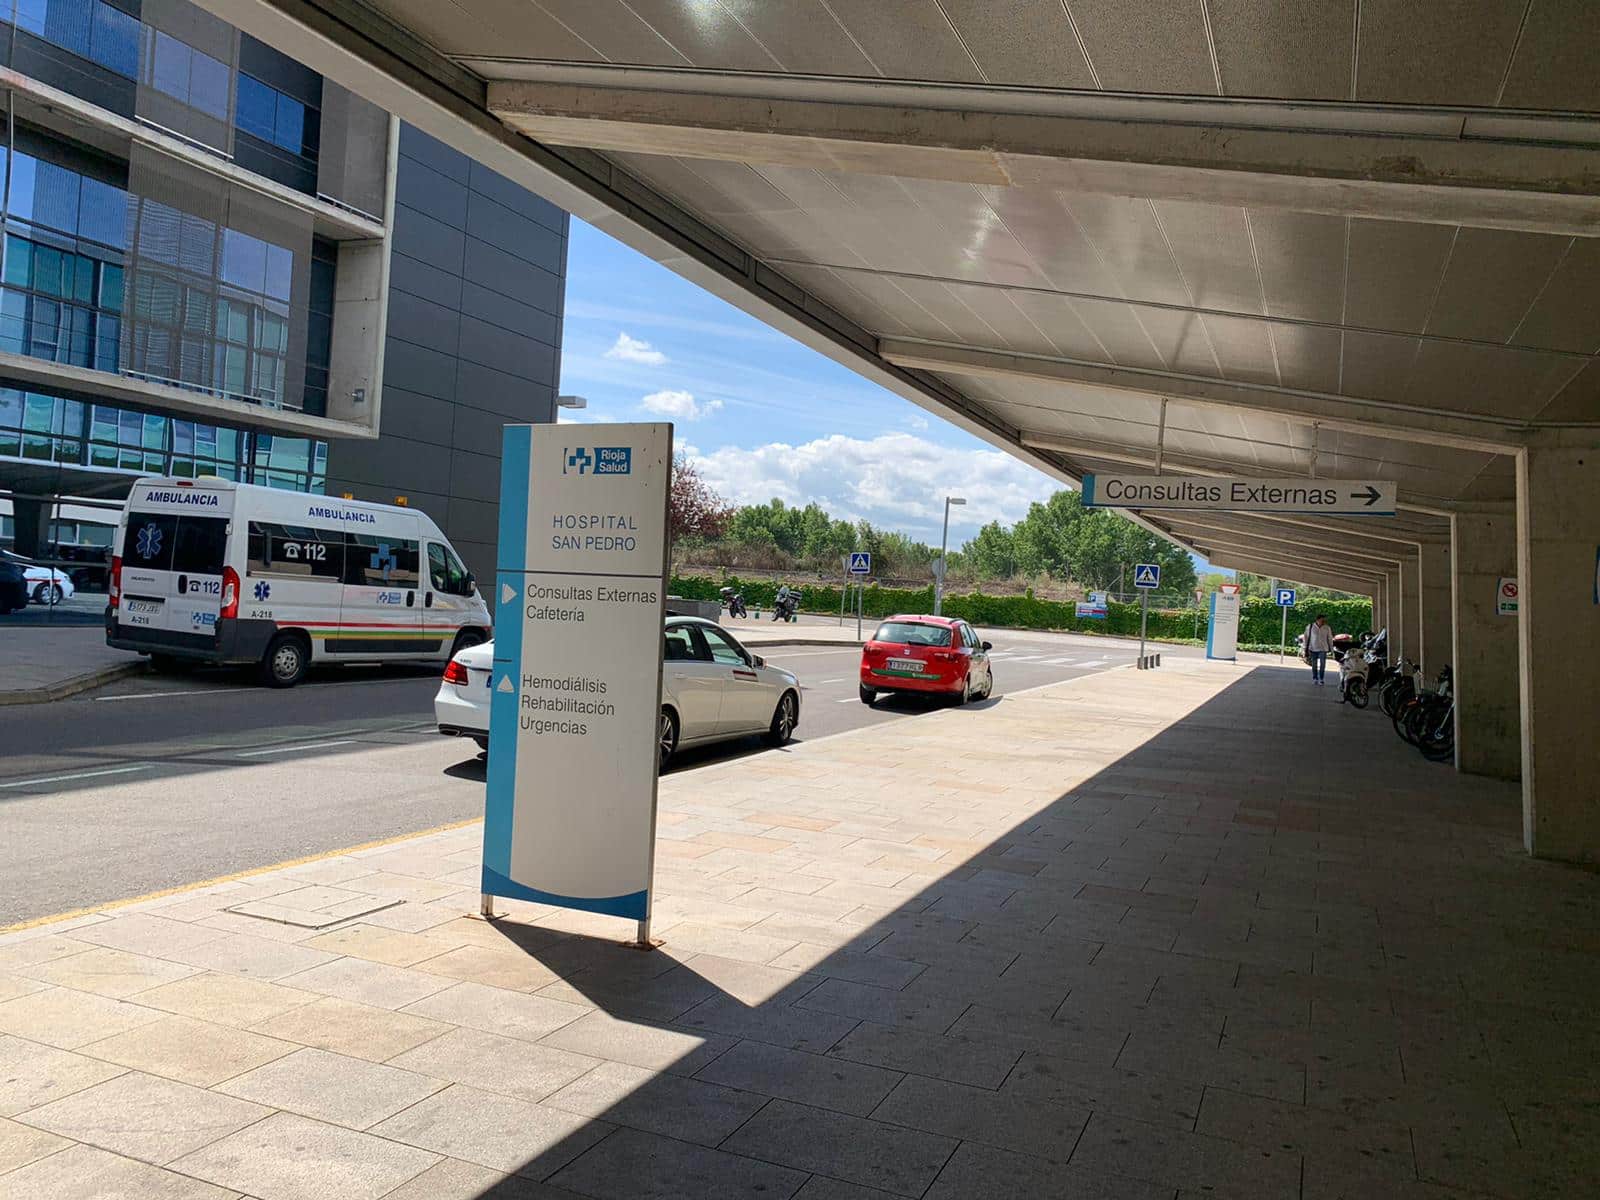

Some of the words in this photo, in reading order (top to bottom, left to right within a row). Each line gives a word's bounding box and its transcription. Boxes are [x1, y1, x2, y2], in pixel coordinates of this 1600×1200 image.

[601, 449, 626, 462] Rioja
[599, 462, 628, 473] Salud
[146, 491, 219, 506] AMBULANCIA
[1105, 479, 1221, 502] Consultas
[1230, 482, 1338, 505] Externas
[308, 506, 376, 524] AMBULANCIA
[552, 514, 638, 530] HOSPITAL
[303, 543, 327, 561] 112
[551, 535, 581, 550] SAN
[585, 536, 636, 551] PEDRO
[203, 581, 220, 595] 112
[527, 583, 593, 601] Consultas
[597, 586, 657, 604] Externas
[1280, 591, 1292, 604] P
[526, 604, 585, 622] Cafetería
[522, 673, 608, 694] Hemodiálisis
[521, 694, 615, 716] Rehabilitación
[520, 715, 588, 735] Urgencias
